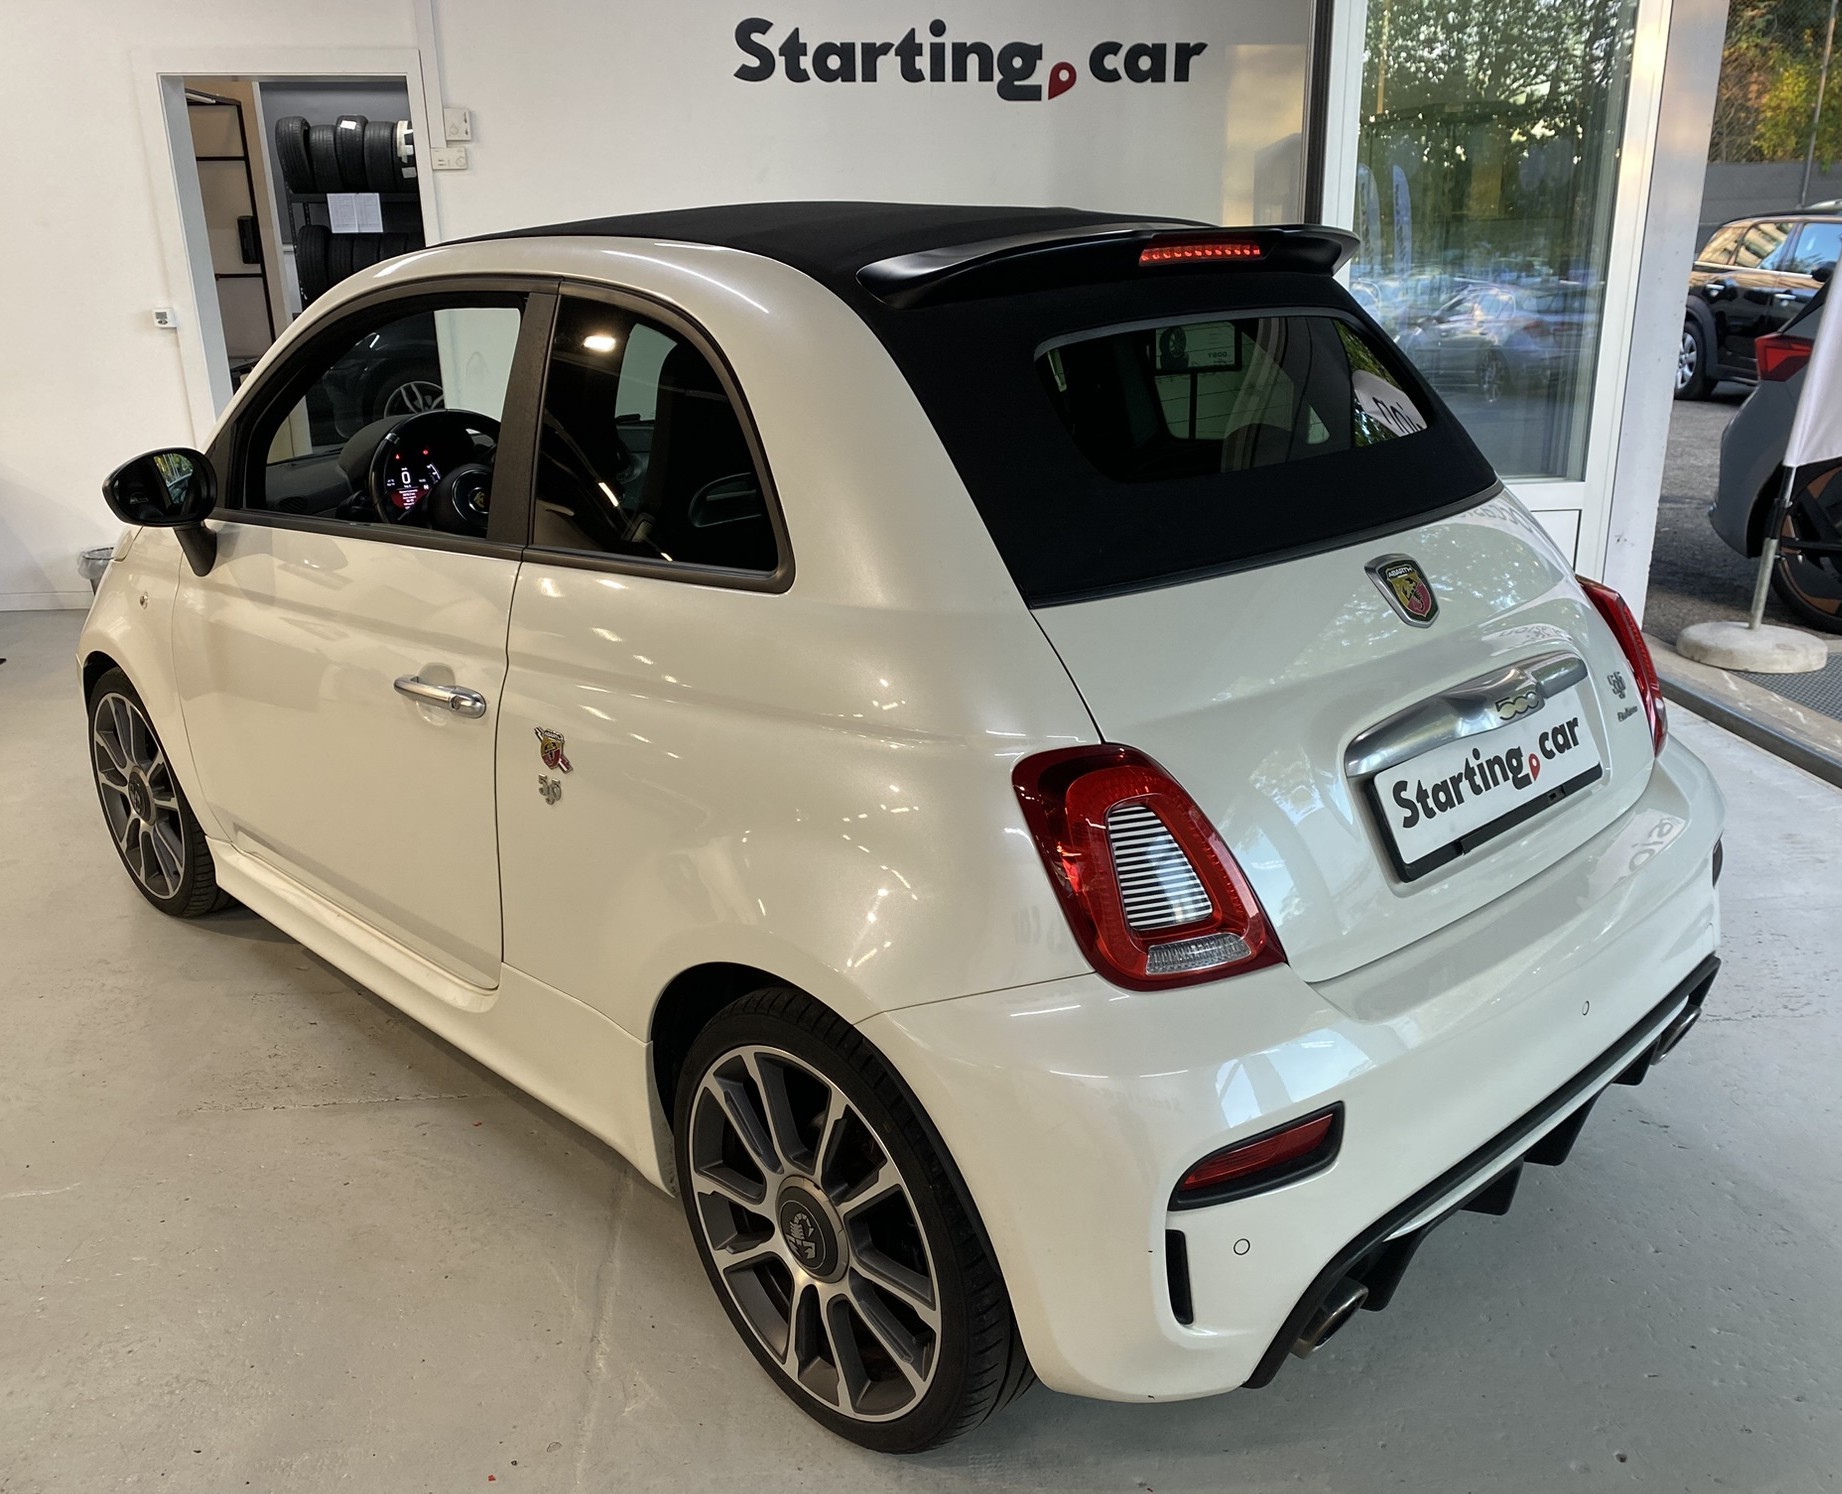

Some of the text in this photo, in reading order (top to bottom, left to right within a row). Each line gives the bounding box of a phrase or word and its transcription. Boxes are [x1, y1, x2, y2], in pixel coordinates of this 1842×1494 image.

[733, 17, 1209, 102] Starting car
[1494, 691, 1540, 721] 500
[1393, 717, 1580, 829] Starting car
